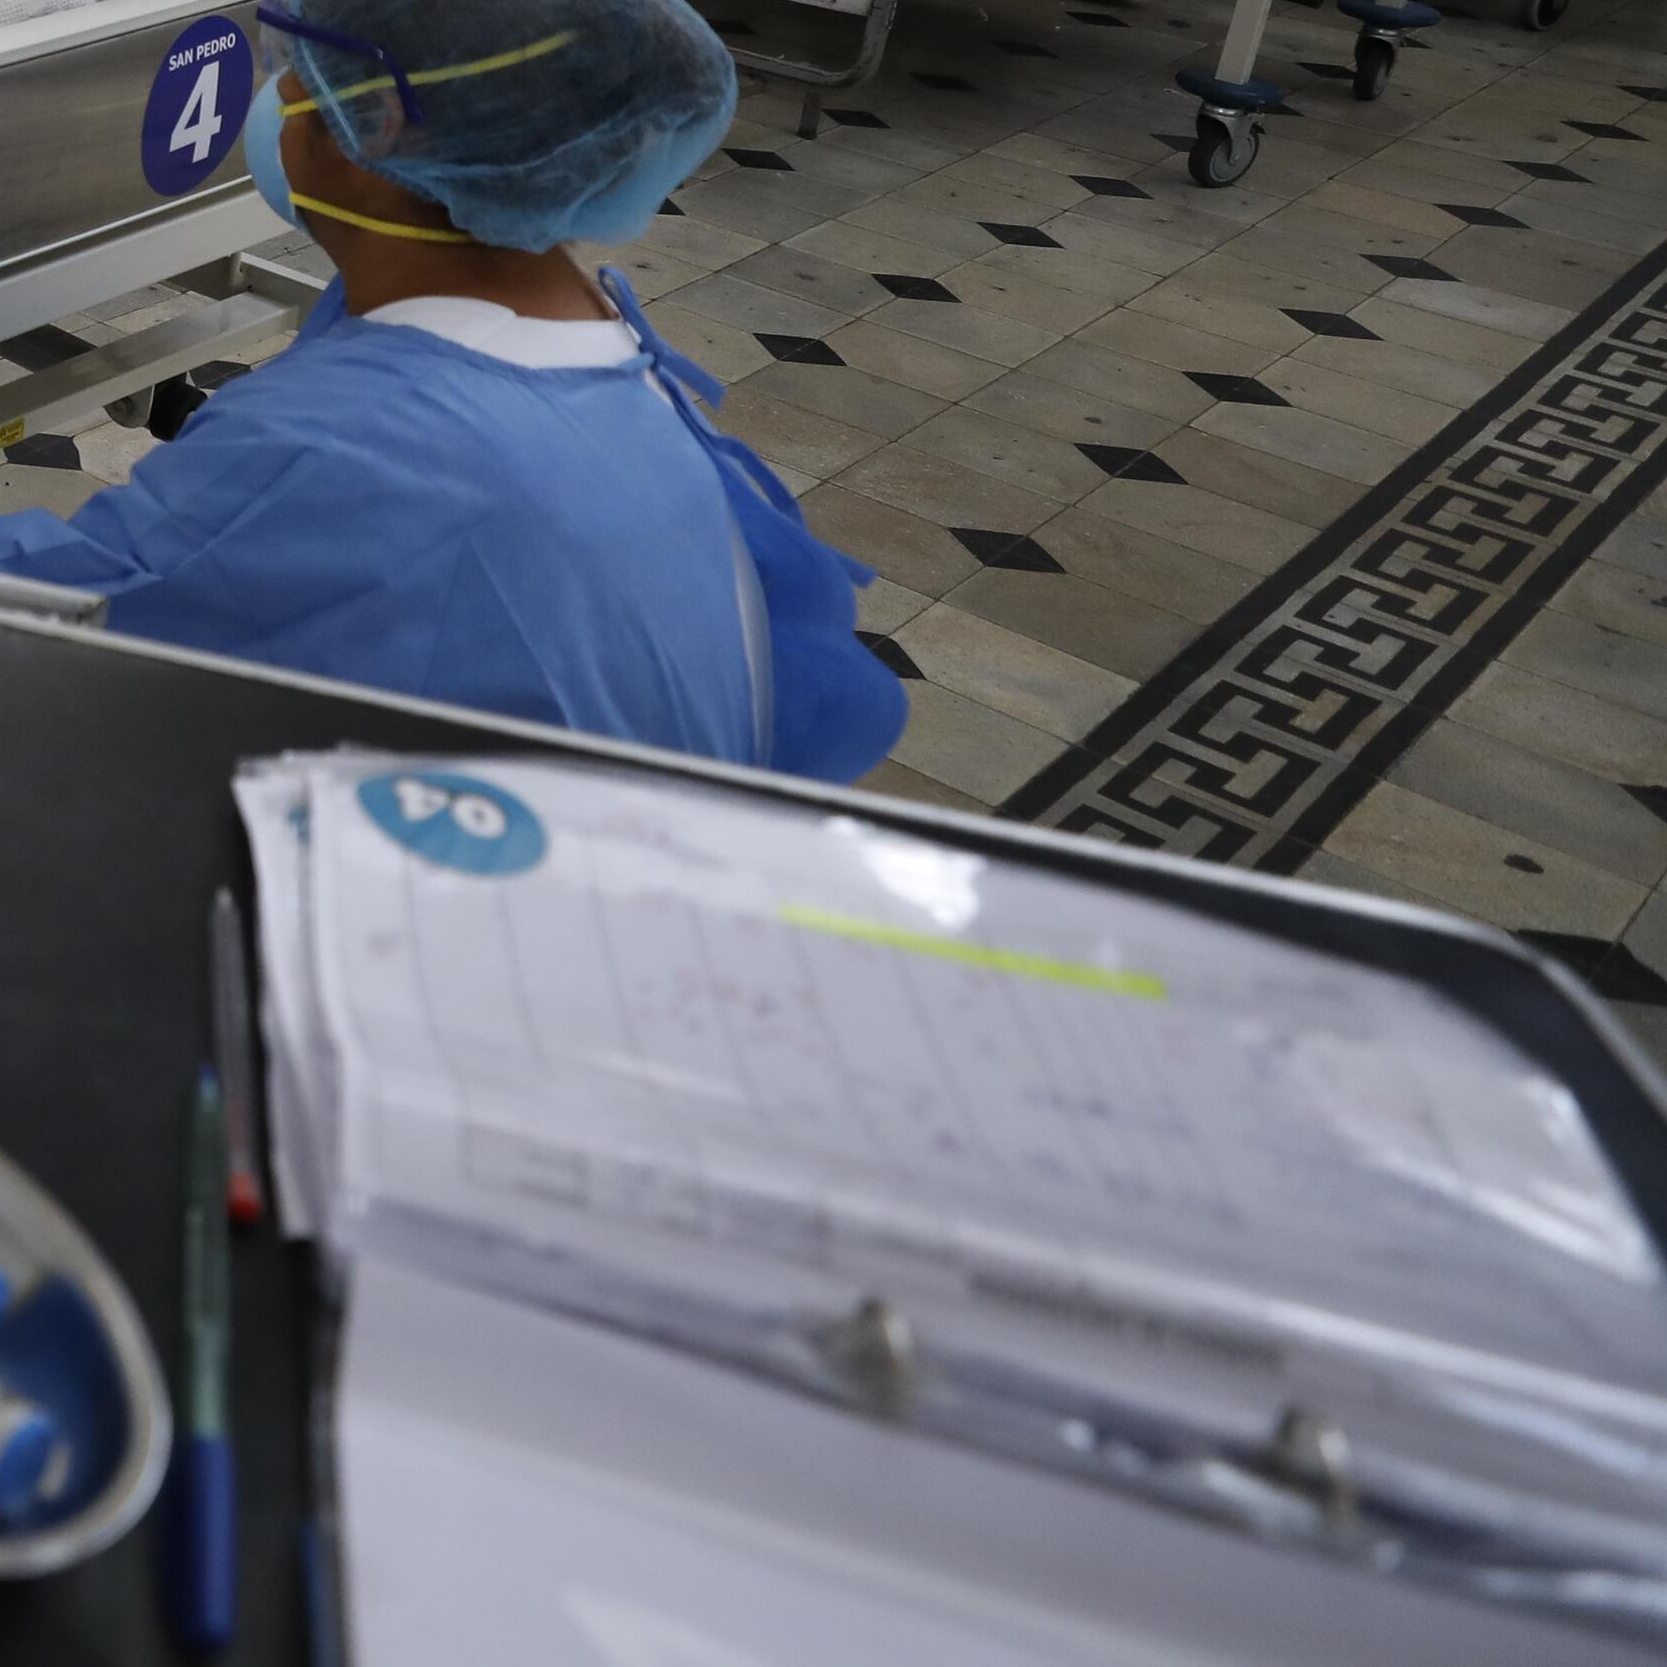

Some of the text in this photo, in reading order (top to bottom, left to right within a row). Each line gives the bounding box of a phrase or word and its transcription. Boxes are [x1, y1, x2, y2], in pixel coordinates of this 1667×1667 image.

[169, 32, 236, 71] SAN PEDRO
[169, 60, 222, 164] 4
[395, 778, 508, 839] 04
